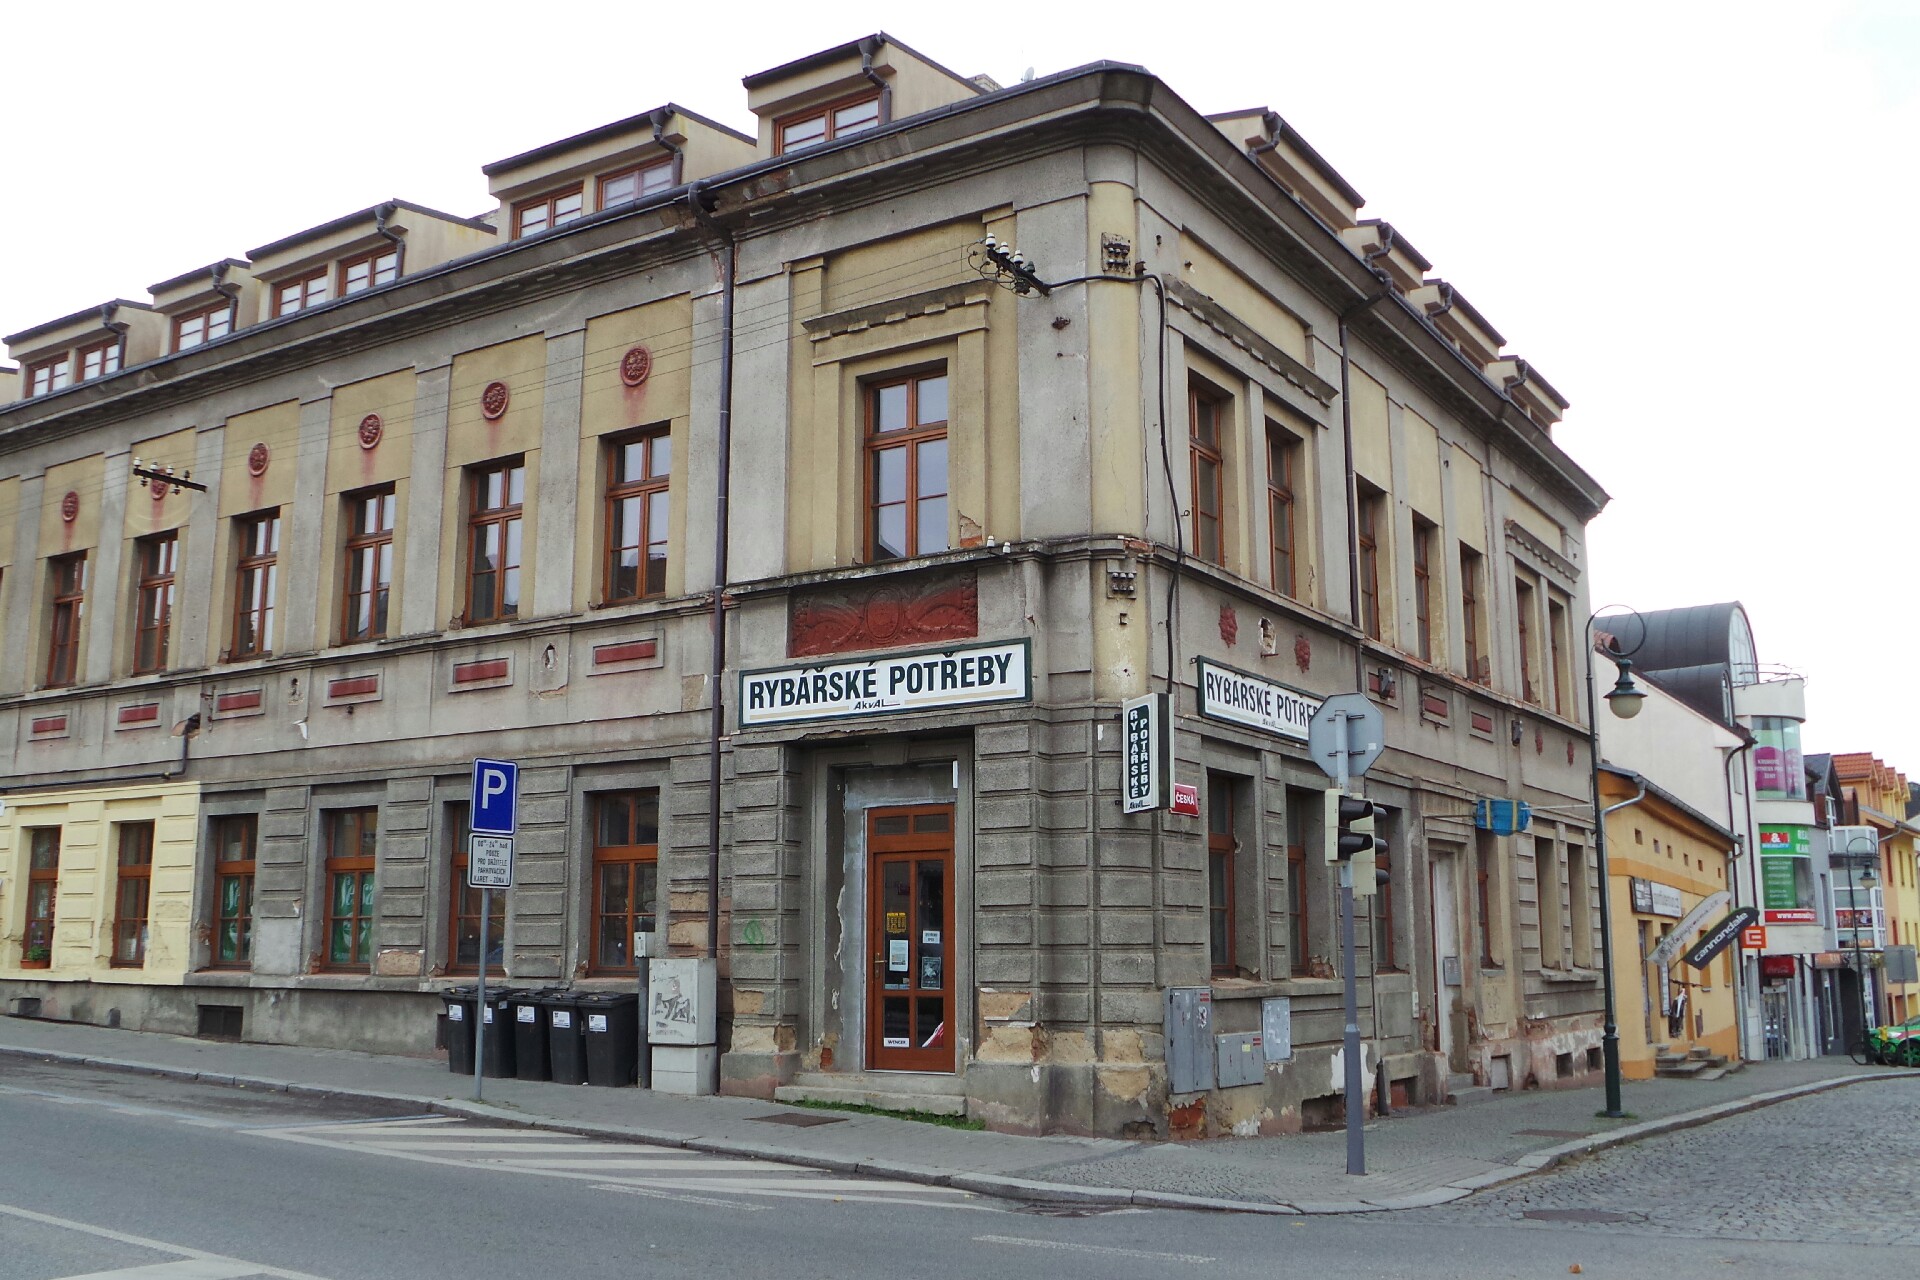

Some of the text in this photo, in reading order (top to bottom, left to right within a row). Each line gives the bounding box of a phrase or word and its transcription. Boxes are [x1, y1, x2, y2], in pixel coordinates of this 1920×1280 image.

[750, 651, 1012, 709] RYBÁŘSKÉ POTŘEBY
[1206, 672, 1272, 717] RYBÁŘSKÉ
[1130, 710, 1139, 797] RYBÁŘSKÉ
[1140, 718, 1149, 796] POTŘEBY
[481, 769, 507, 809] P
[1176, 791, 1195, 805] ČESKÁ
[1694, 912, 1749, 962] cannondale
